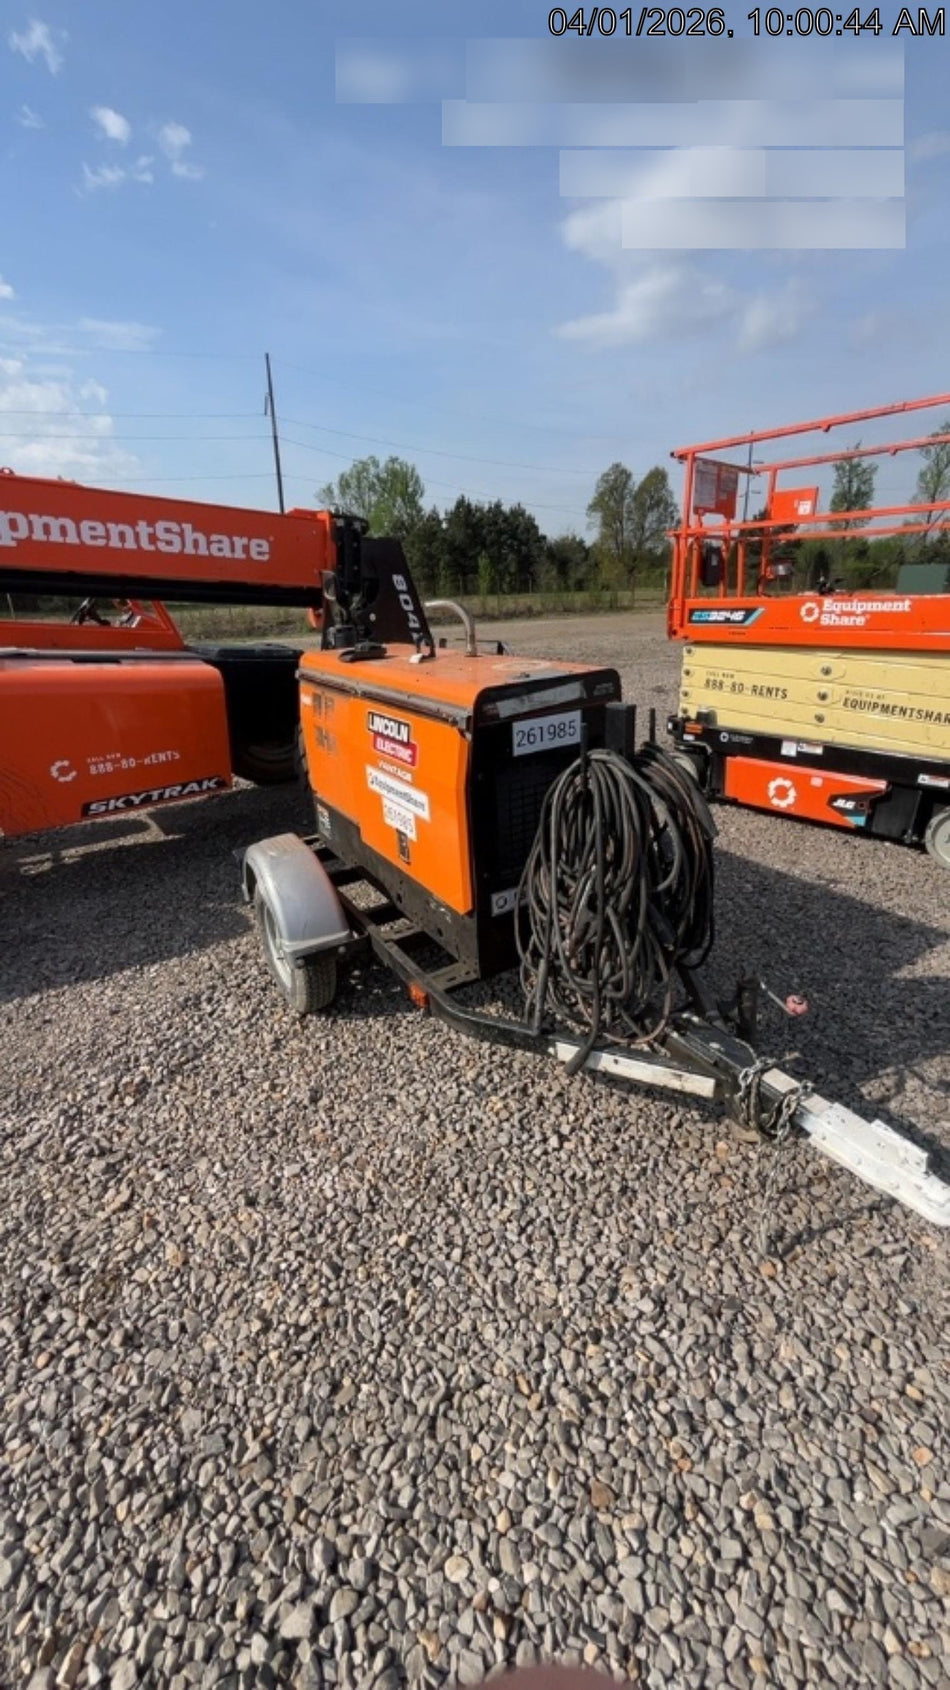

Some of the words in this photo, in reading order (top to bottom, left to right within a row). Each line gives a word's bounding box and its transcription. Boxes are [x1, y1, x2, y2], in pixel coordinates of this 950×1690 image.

[0, 509, 270, 562] pmentShare
[820, 613, 866, 626] Share
[823, 597, 911, 614] Equipment
[369, 713, 408, 743] LINCOLN
[516, 720, 577, 748] 261985
[88, 776, 220, 814] SKYTRAK
